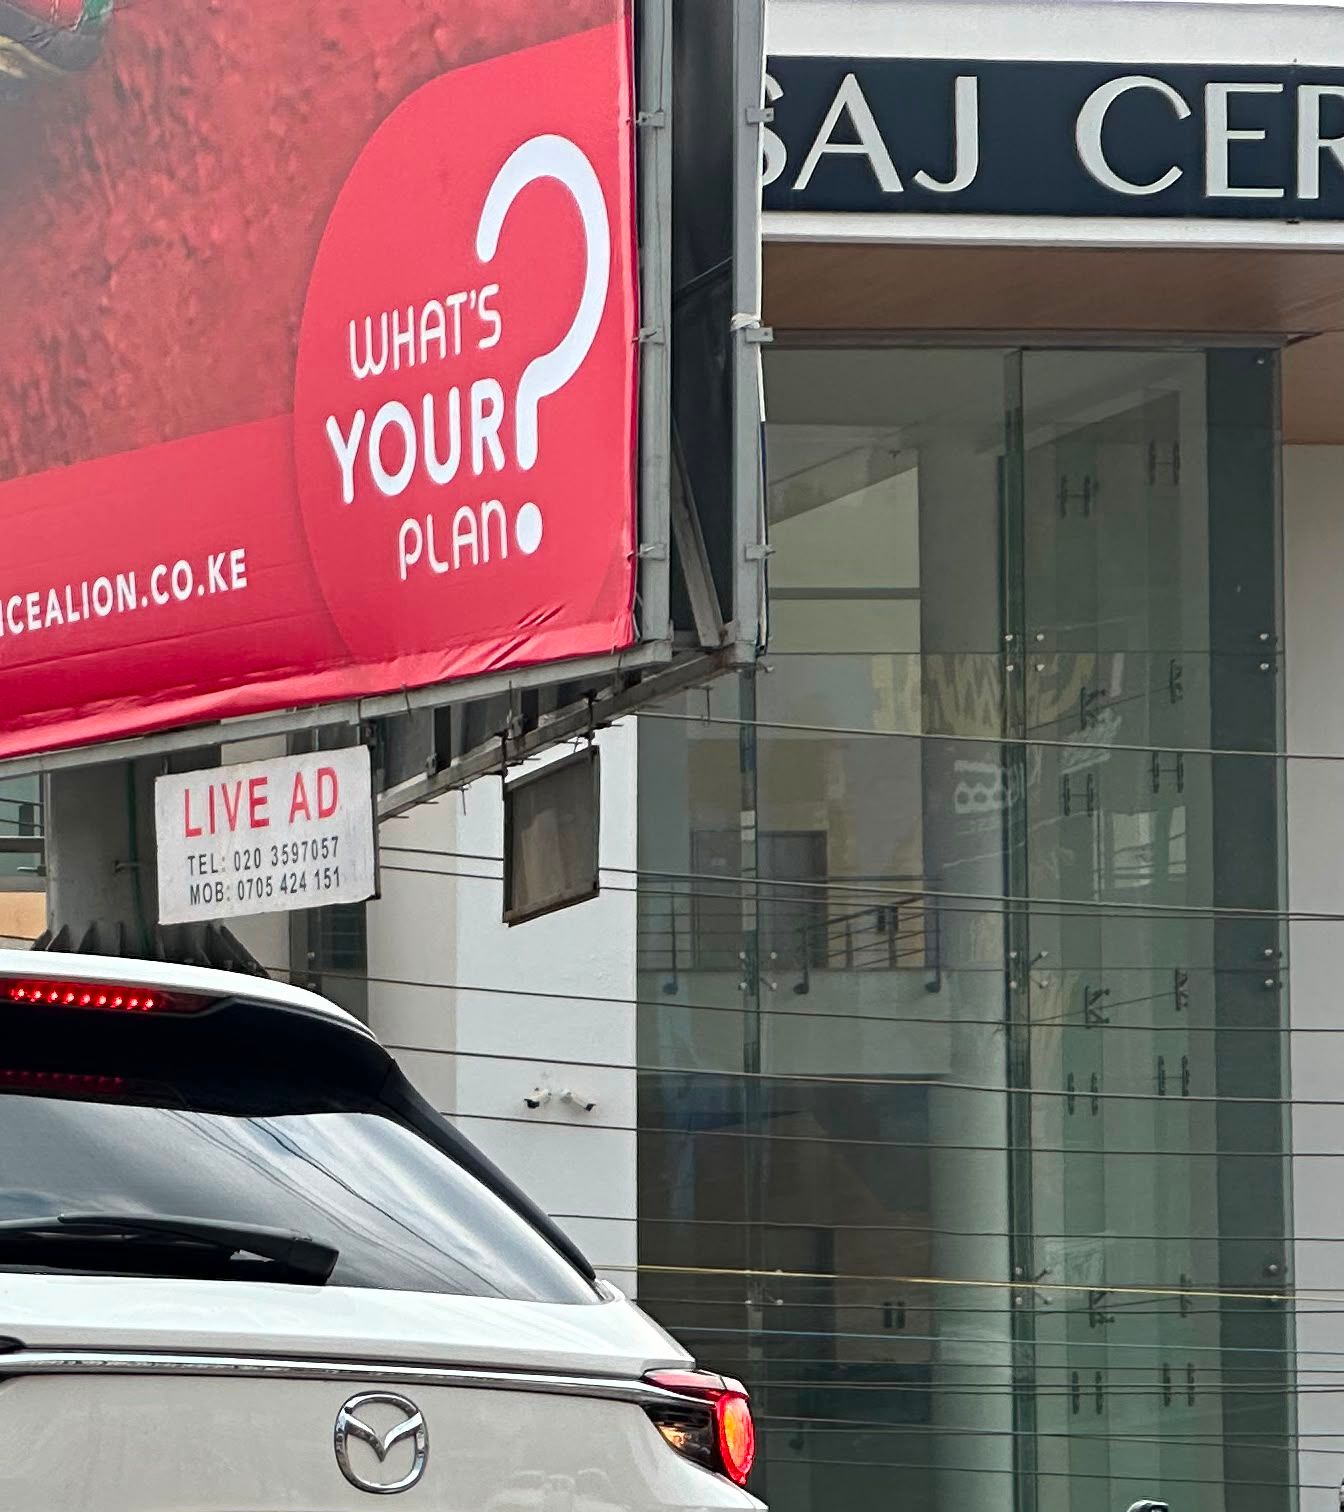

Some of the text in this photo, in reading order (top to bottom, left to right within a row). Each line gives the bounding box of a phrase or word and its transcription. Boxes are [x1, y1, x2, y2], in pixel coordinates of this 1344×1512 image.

[1075, 75, 1344, 199] CER
[348, 283, 503, 379] WHAT'S
[325, 377, 505, 504] YOUR
[183, 766, 339, 838] LIVE AD
[187, 836, 339, 876] TEL: 020 3597057
[190, 866, 340, 905] MOB: 0705 424 151
